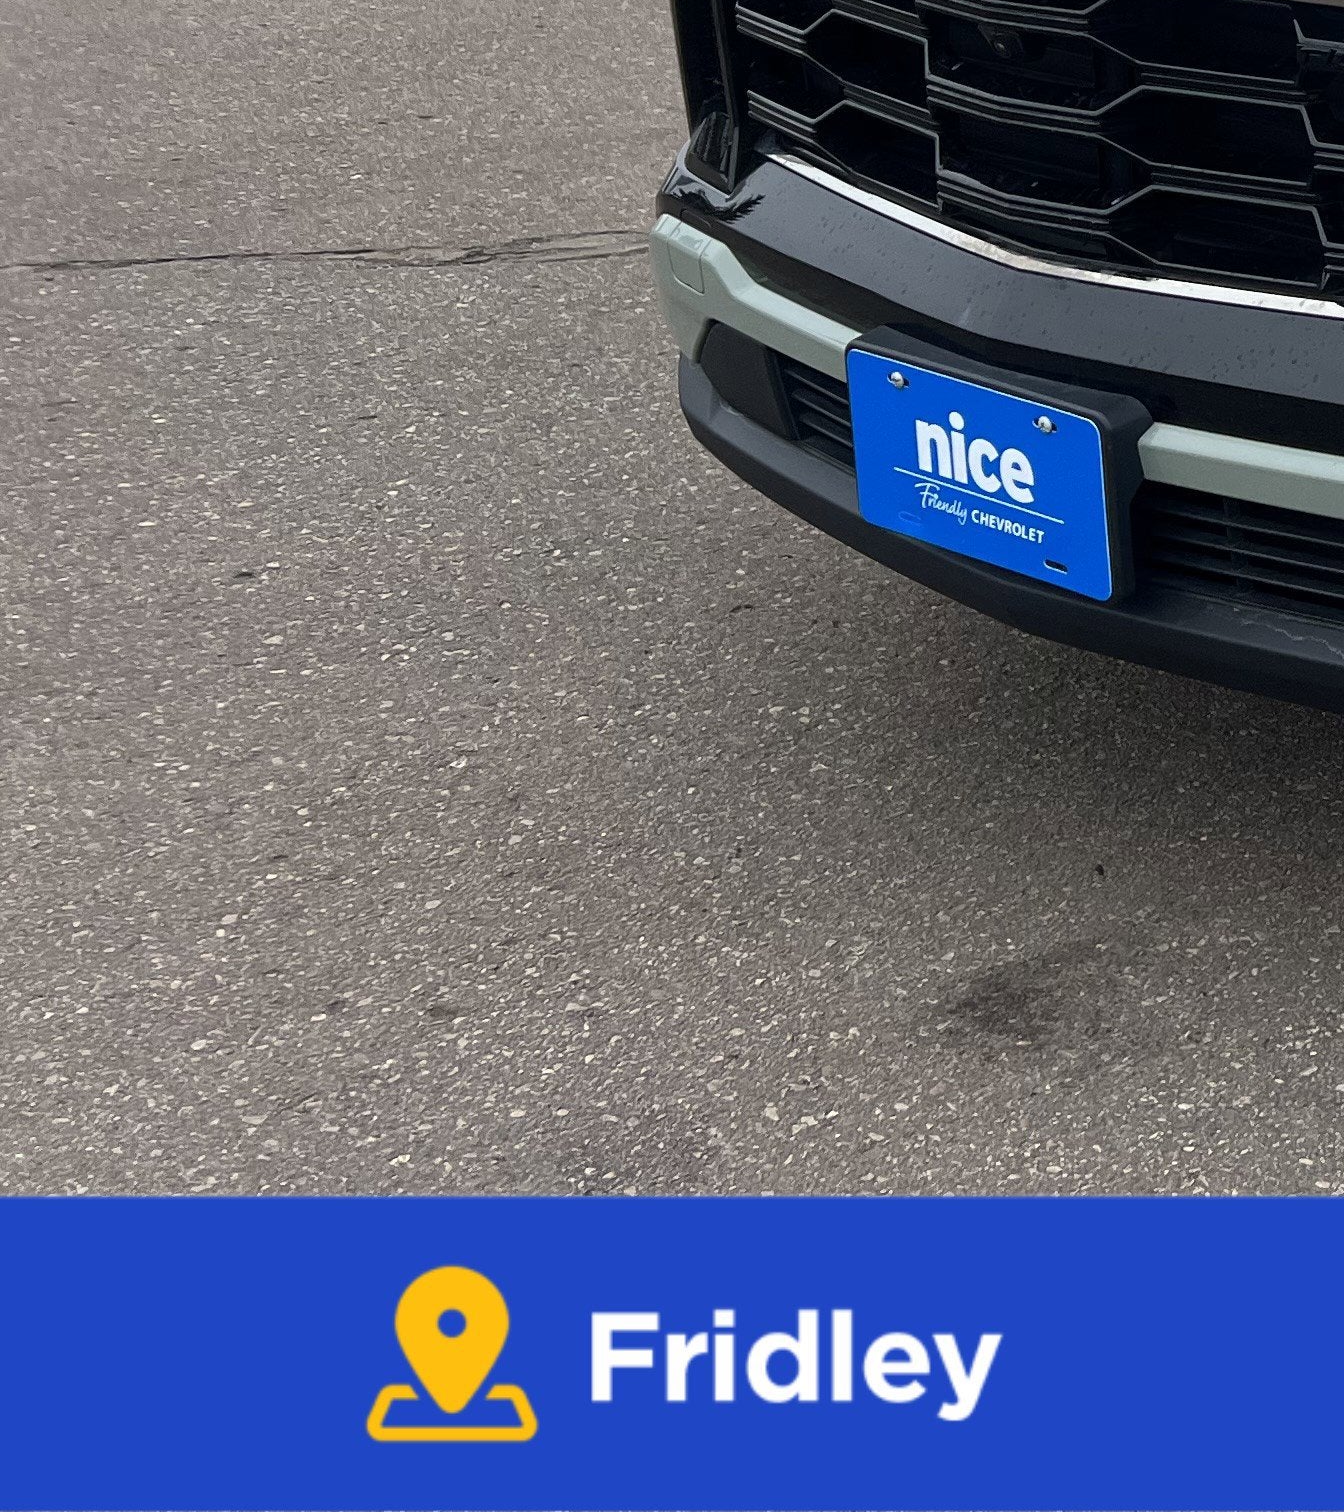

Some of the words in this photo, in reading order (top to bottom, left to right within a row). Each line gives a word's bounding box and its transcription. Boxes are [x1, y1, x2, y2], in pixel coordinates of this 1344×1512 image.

[914, 410, 1035, 504] nice
[914, 481, 969, 525] Friendly
[971, 509, 1045, 544] CHEVROLET
